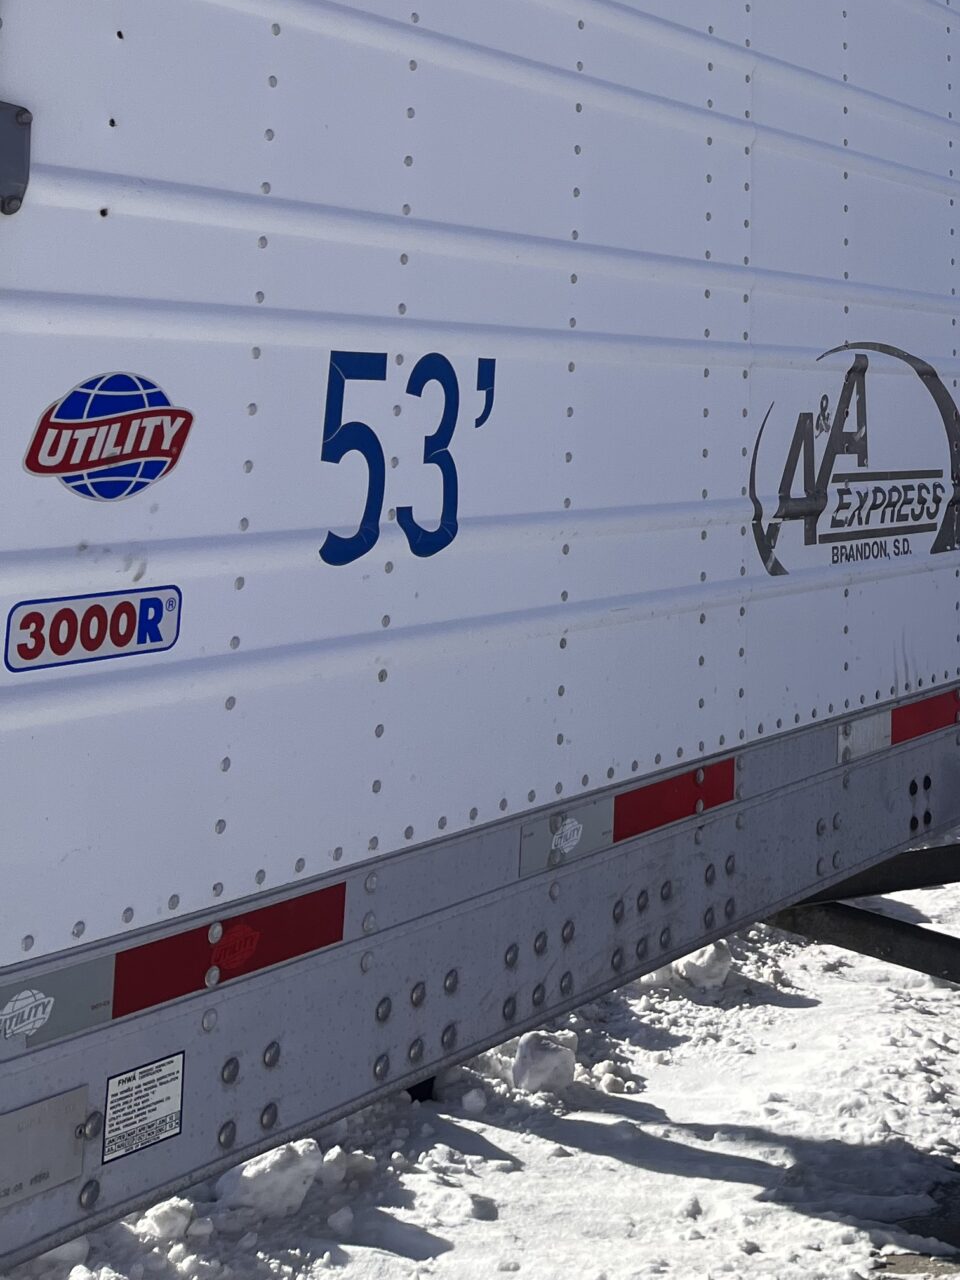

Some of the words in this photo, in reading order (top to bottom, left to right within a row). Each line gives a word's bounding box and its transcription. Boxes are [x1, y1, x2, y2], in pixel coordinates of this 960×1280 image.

[37, 416, 186, 467] UTILITY
[830, 482, 945, 528] EXPRESS
[831, 544, 890, 565] BRANDON,
[893, 538, 912, 556] S.D.
